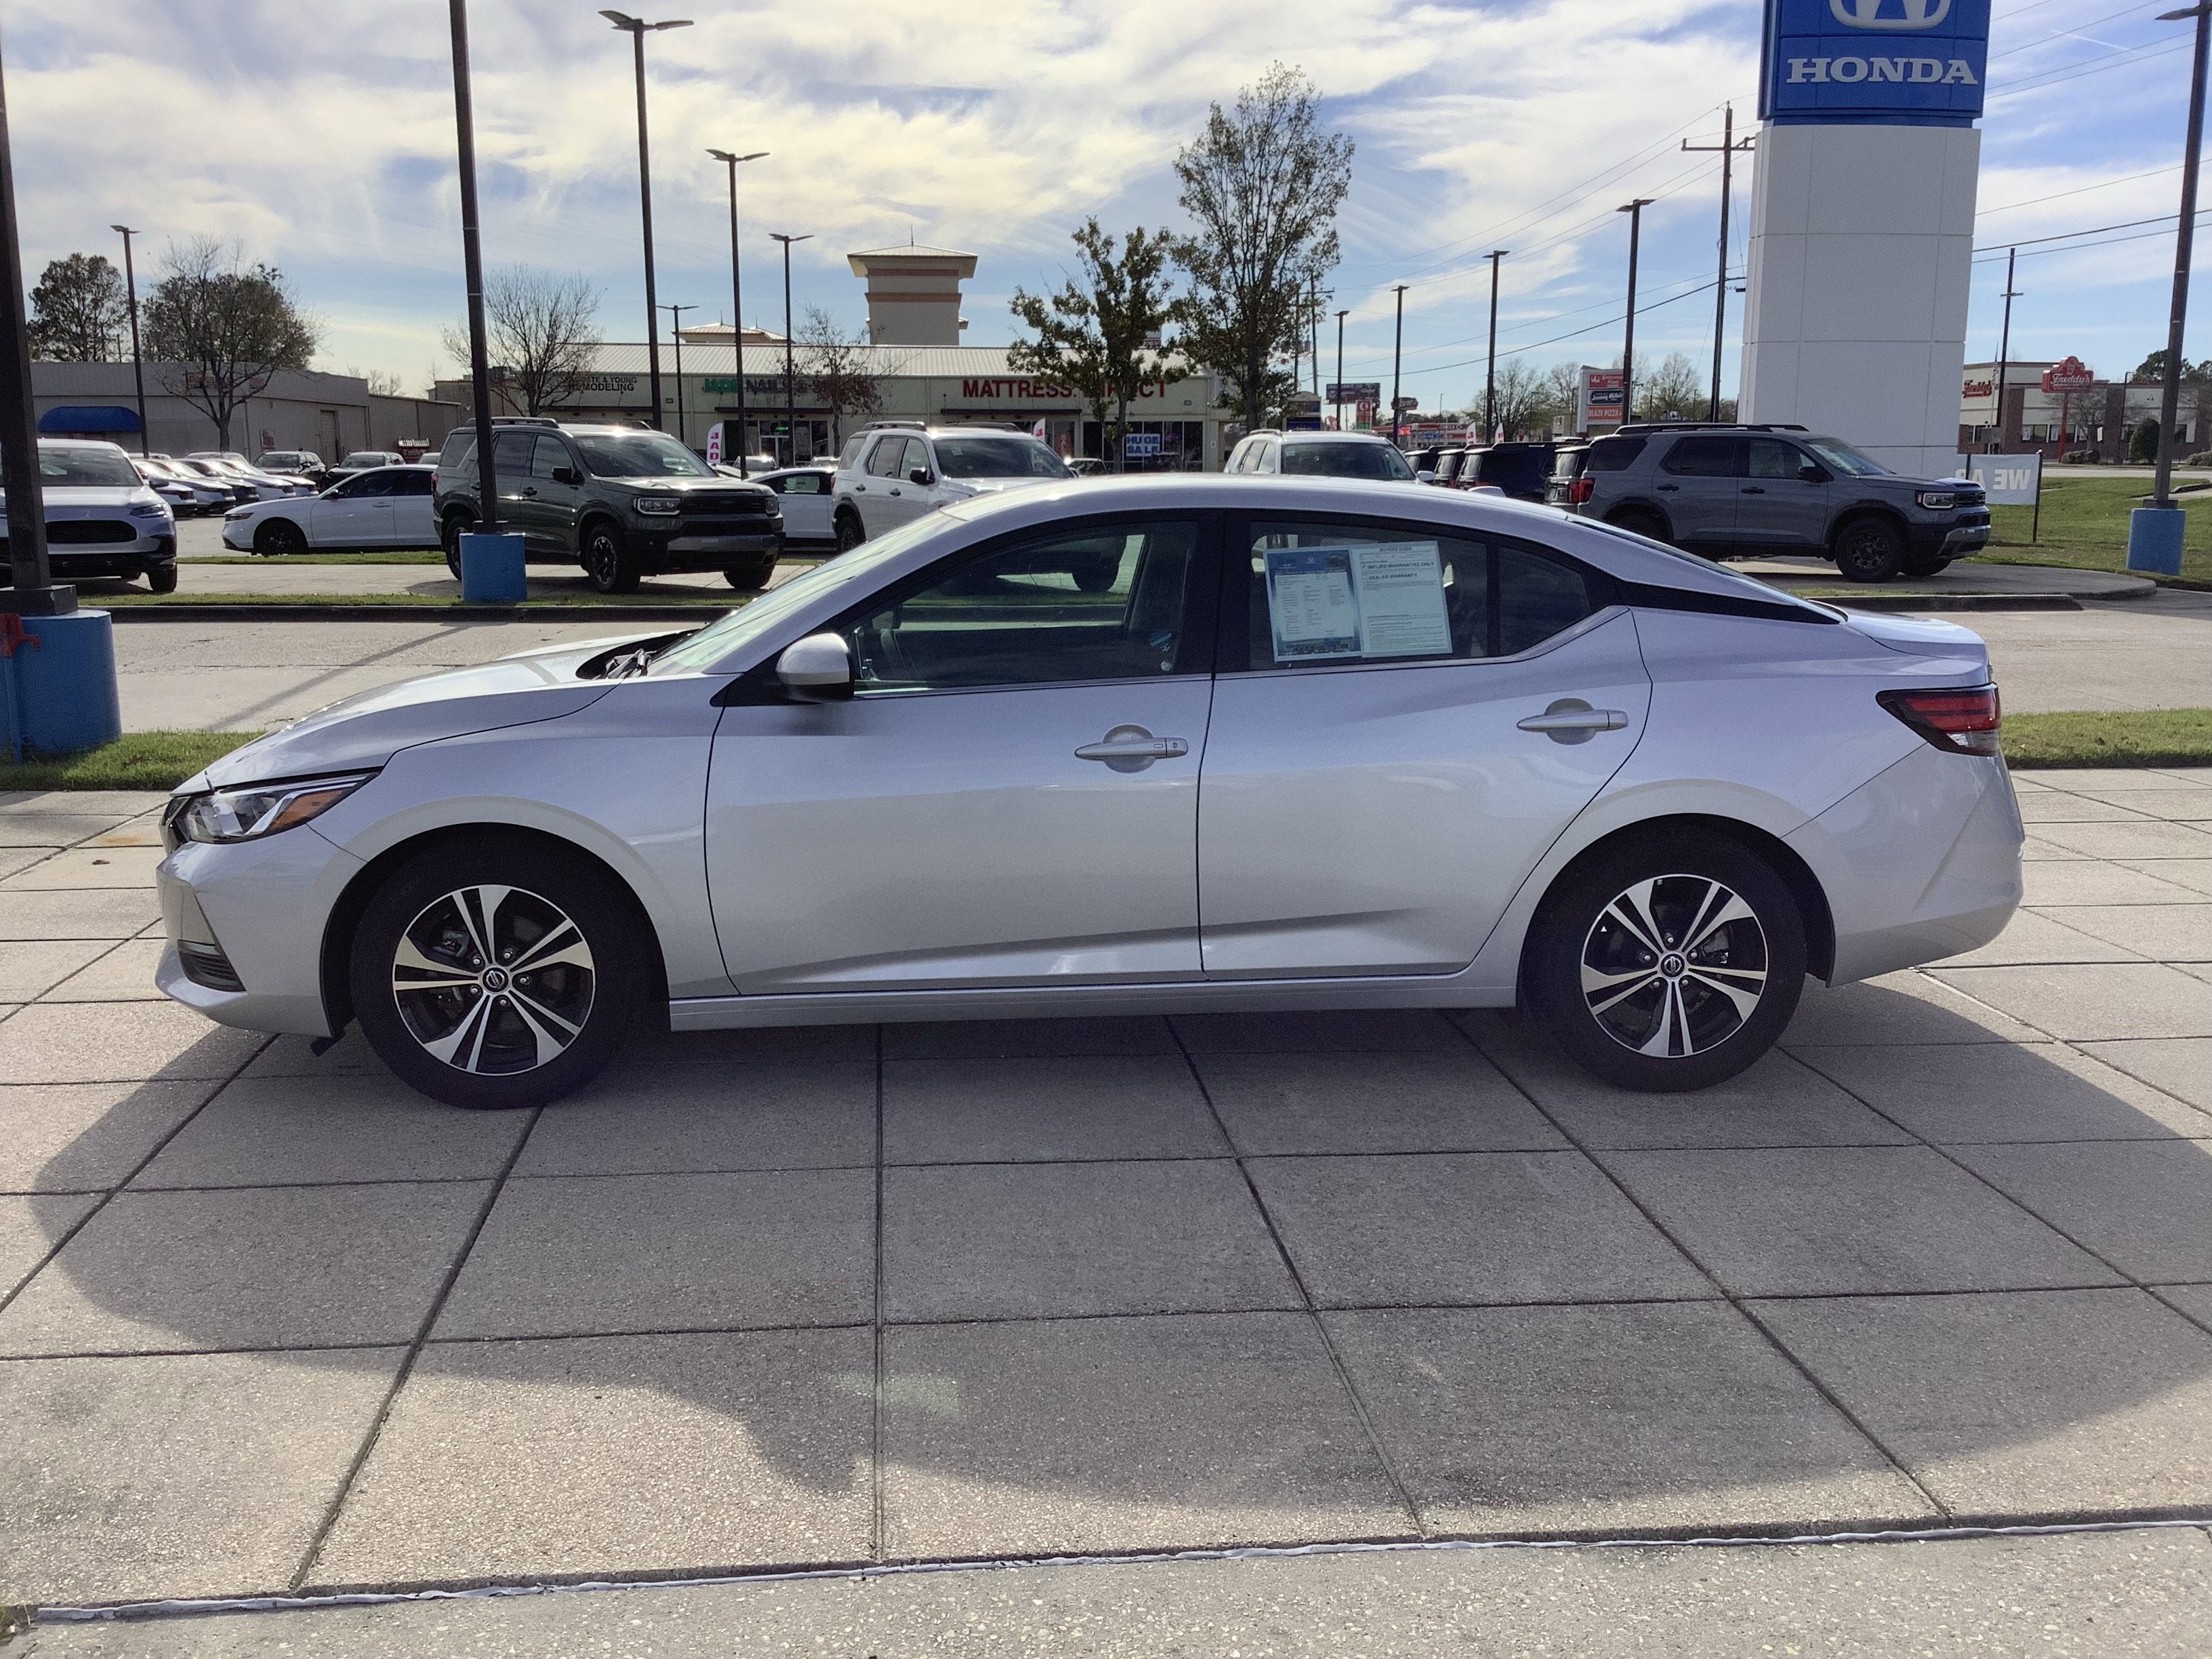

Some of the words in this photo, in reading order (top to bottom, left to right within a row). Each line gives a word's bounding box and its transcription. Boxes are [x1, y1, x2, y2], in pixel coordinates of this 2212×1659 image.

[1786, 57, 1979, 85] HONDA
[2050, 373, 2091, 386] Freddy's
[963, 380, 1072, 398] MATTRESS
[1127, 436, 1159, 445] HUGE
[1127, 445, 1159, 454] SALE
